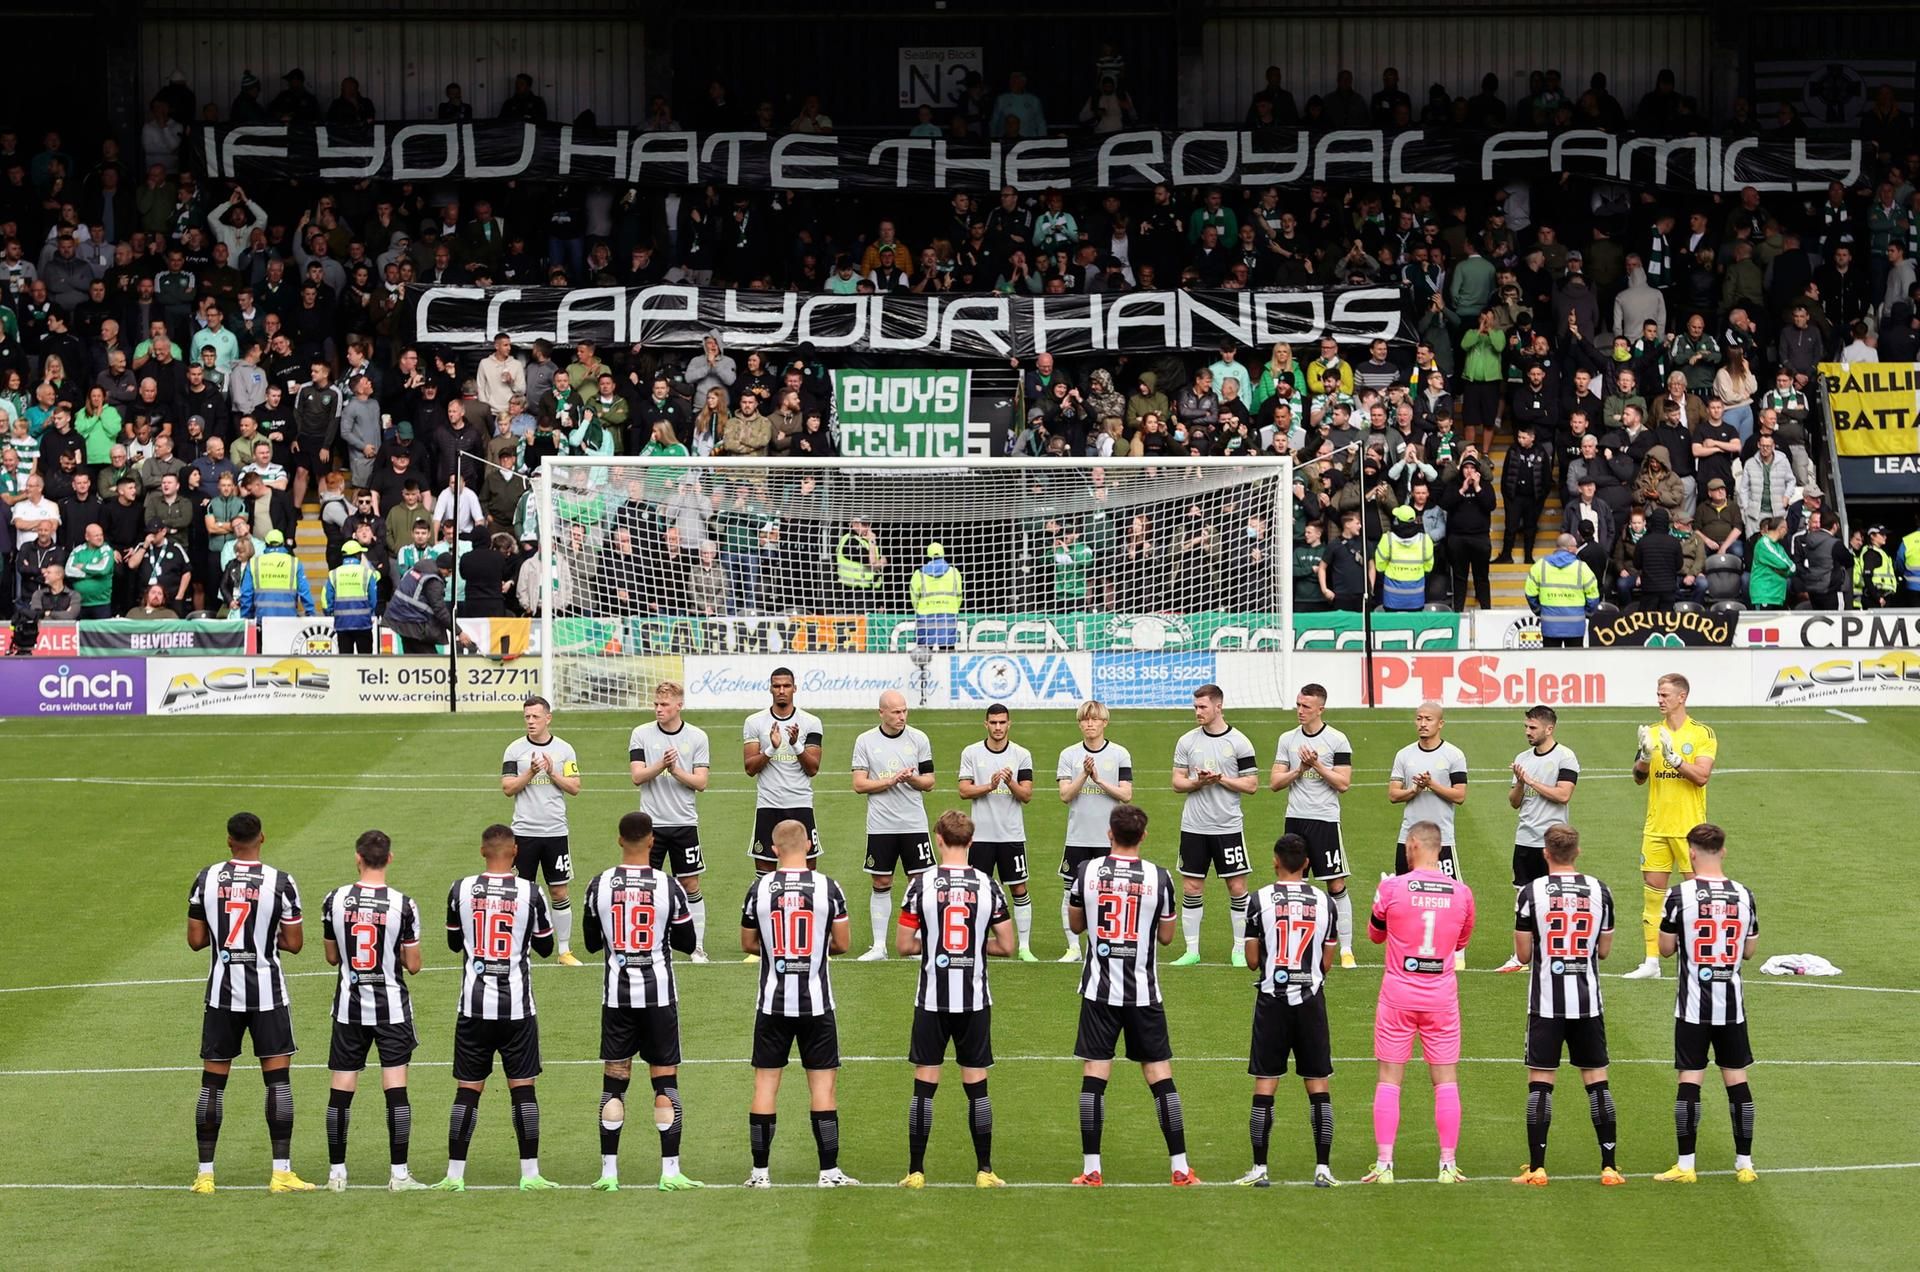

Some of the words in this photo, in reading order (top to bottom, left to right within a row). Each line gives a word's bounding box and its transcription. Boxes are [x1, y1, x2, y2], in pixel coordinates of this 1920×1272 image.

[904, 50, 944, 62] Seating
[948, 49, 977, 60] Block
[910, 64, 970, 105] N3
[204, 126, 288, 178] IF
[316, 123, 536, 180] YOU
[559, 126, 839, 189] HATE
[868, 138, 1071, 191] THE
[723, 288, 1015, 357] YOUR
[1033, 287, 1401, 355] HANDS
[842, 375, 959, 413] BHOYS
[1824, 371, 1920, 394] BAILLI
[839, 423, 960, 457] CELTIC
[1874, 457, 1920, 474] LEA
[130, 633, 194, 650] BELVIDERE
[640, 621, 861, 653] CARMYLE
[1800, 615, 1920, 647] CPM
[38, 664, 133, 698] cinch
[159, 664, 330, 709] ACRE
[357, 668, 389, 684] Tel:
[468, 668, 539, 684] 327711
[949, 656, 1084, 700] KOVA
[1097, 666, 1136, 680] 0333
[1140, 666, 1169, 680] 355
[1172, 666, 1211, 680] 5225
[39, 702, 61, 711] Cars
[62, 702, 97, 711] without
[99, 702, 114, 711] the
[115, 702, 133, 711] faff
[168, 701, 200, 713] Serving
[202, 695, 232, 706] British
[233, 691, 271, 702] Industry
[1808, 688, 1838, 700] British
[1840, 684, 1878, 695] Industry
[571, 763, 578, 773] C
[554, 855, 570, 872] 42
[685, 846, 702, 864] 57
[917, 841, 931, 860] 13
[1013, 854, 1026, 873] 11
[1224, 846, 1244, 866] 56
[1325, 849, 1340, 868] 14
[1097, 894, 1141, 940] 31
[1411, 895, 1451, 909] CARSON
[1550, 896, 1590, 909] FRASER
[1700, 903, 1739, 917] STRAIN
[224, 901, 251, 948] 7
[472, 910, 515, 959] 16
[610, 904, 656, 951] 18
[770, 910, 814, 956] 10
[943, 904, 970, 953] 6
[1417, 910, 1436, 956] 1
[1545, 911, 1594, 958] 22
[351, 923, 377, 970] 3
[1273, 920, 1317, 968] 17
[1693, 918, 1741, 966] 23
